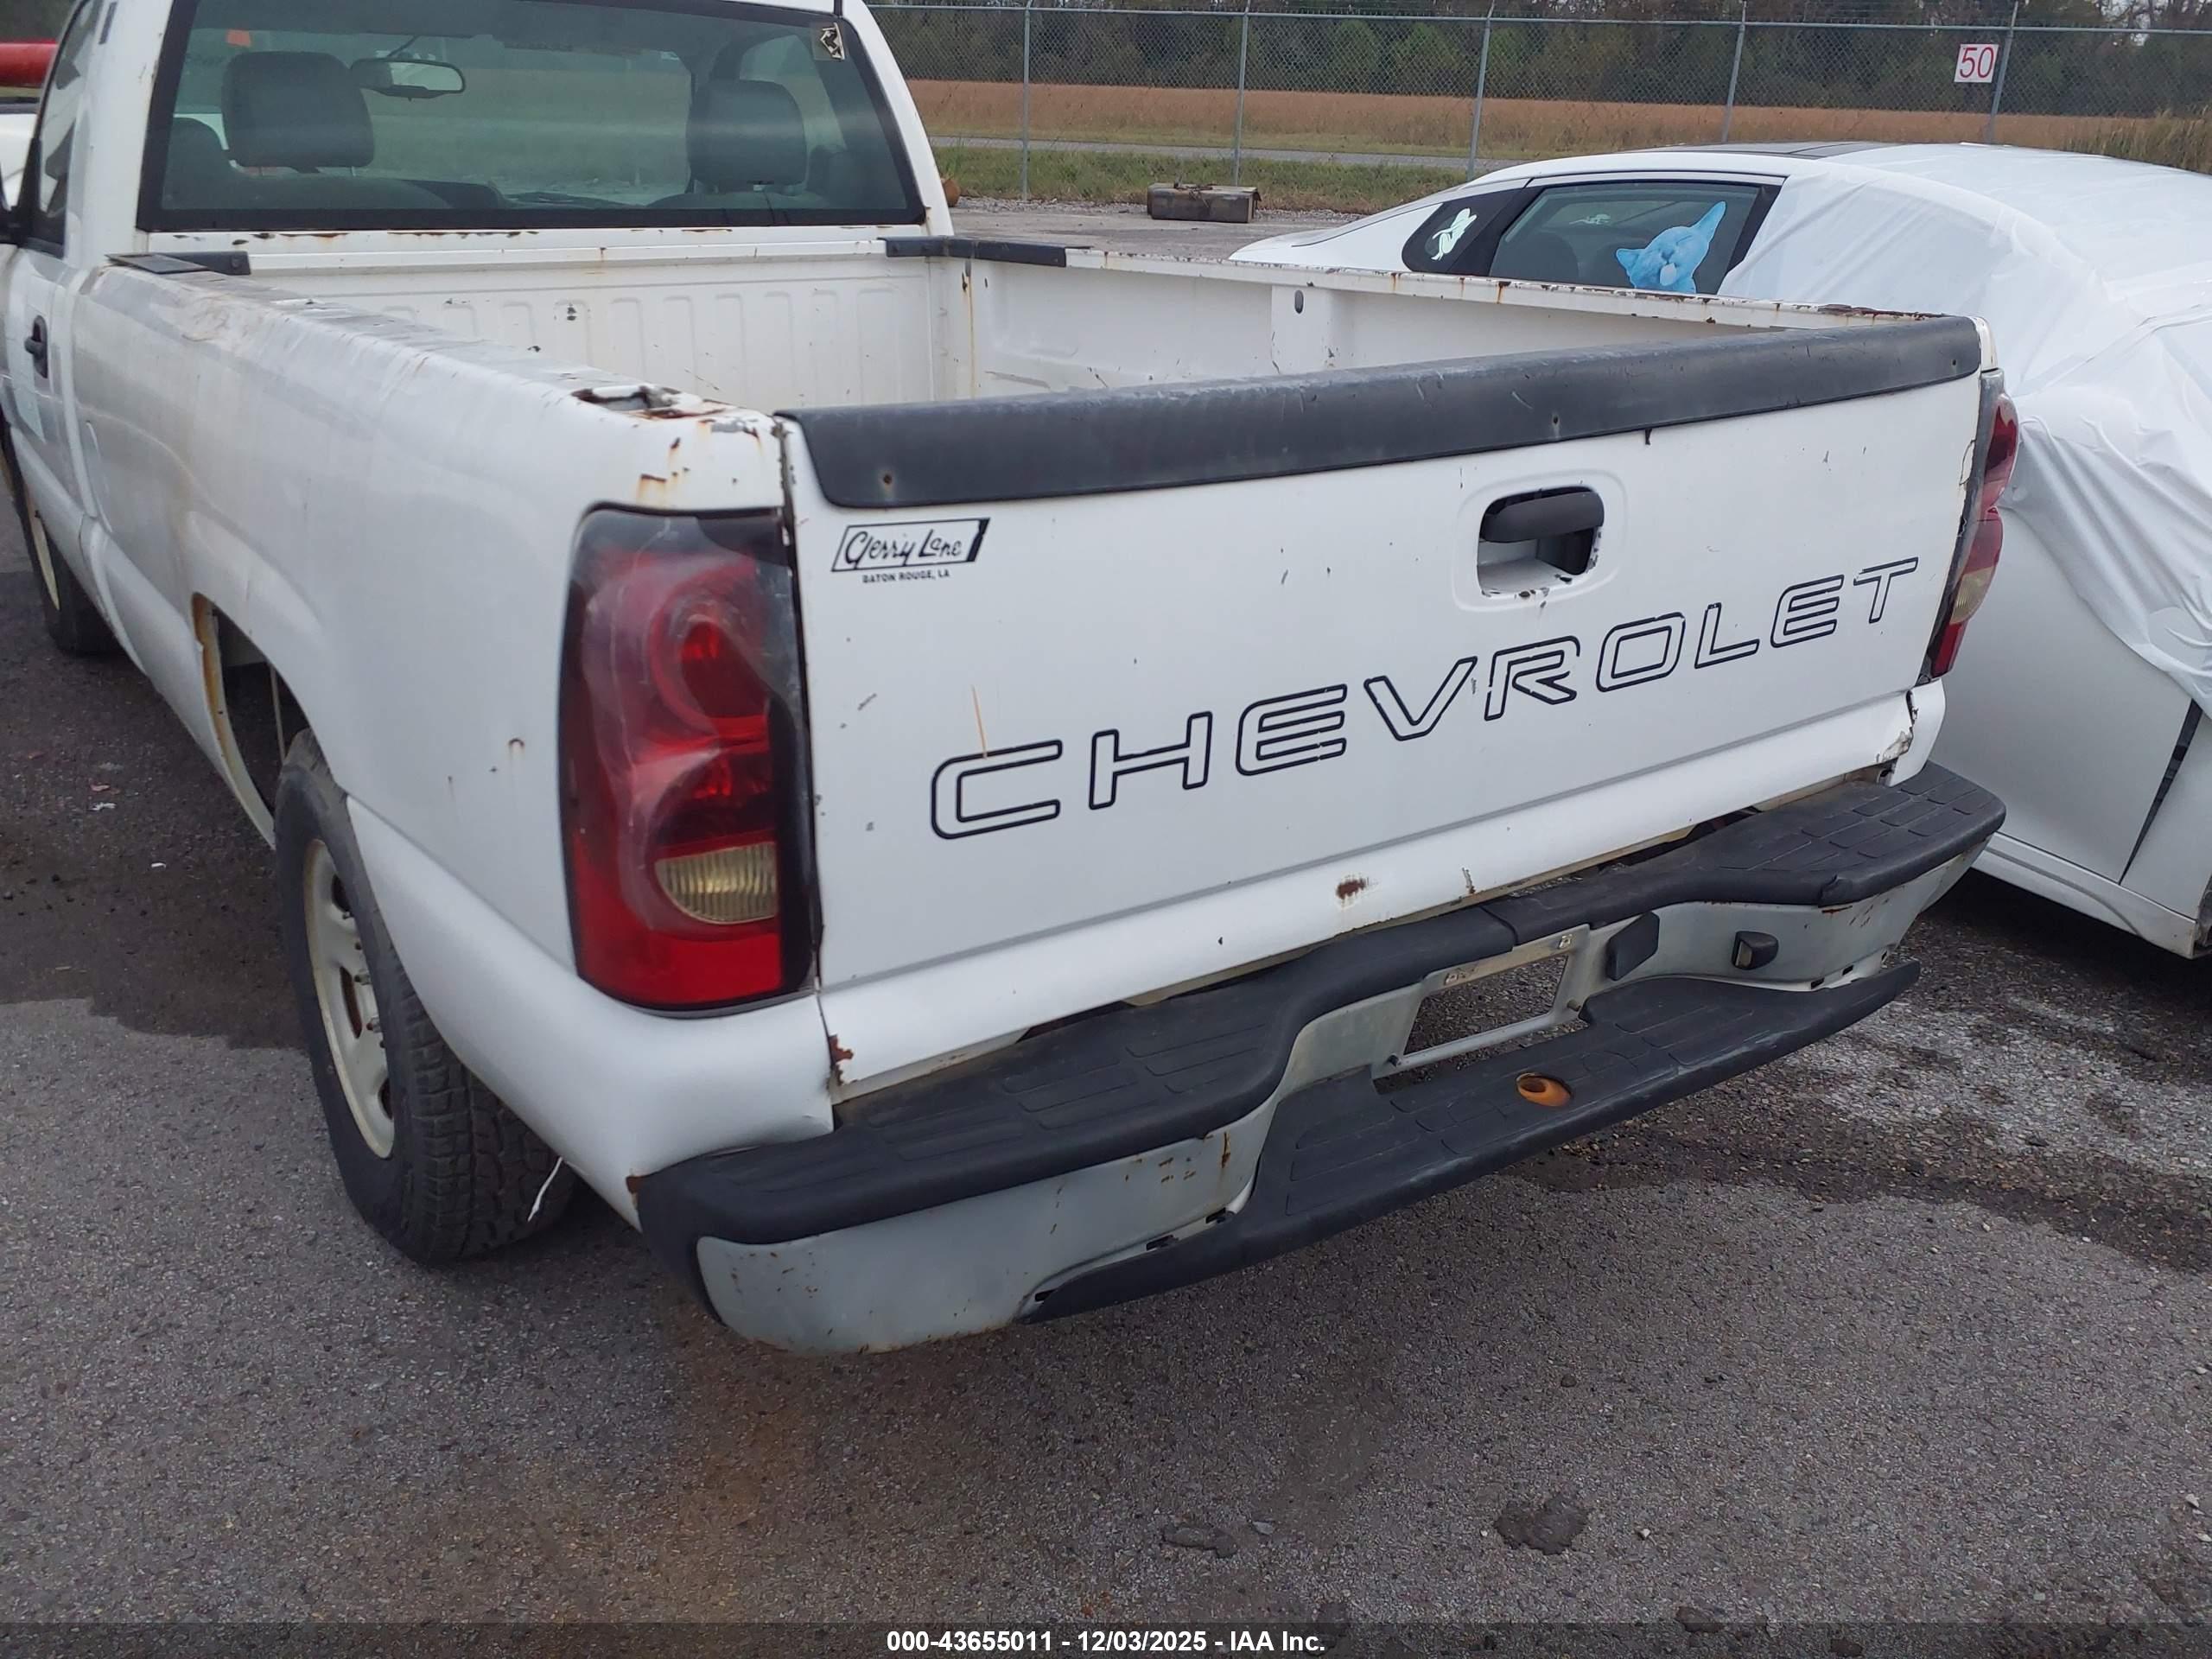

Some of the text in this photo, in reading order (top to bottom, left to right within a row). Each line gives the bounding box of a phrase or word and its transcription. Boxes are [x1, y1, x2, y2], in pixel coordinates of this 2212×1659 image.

[1959, 46, 1995, 79] 50
[844, 528, 963, 568] Gerry Lane
[938, 569, 950, 577] LA
[931, 556, 1919, 840] CHEVROLET
